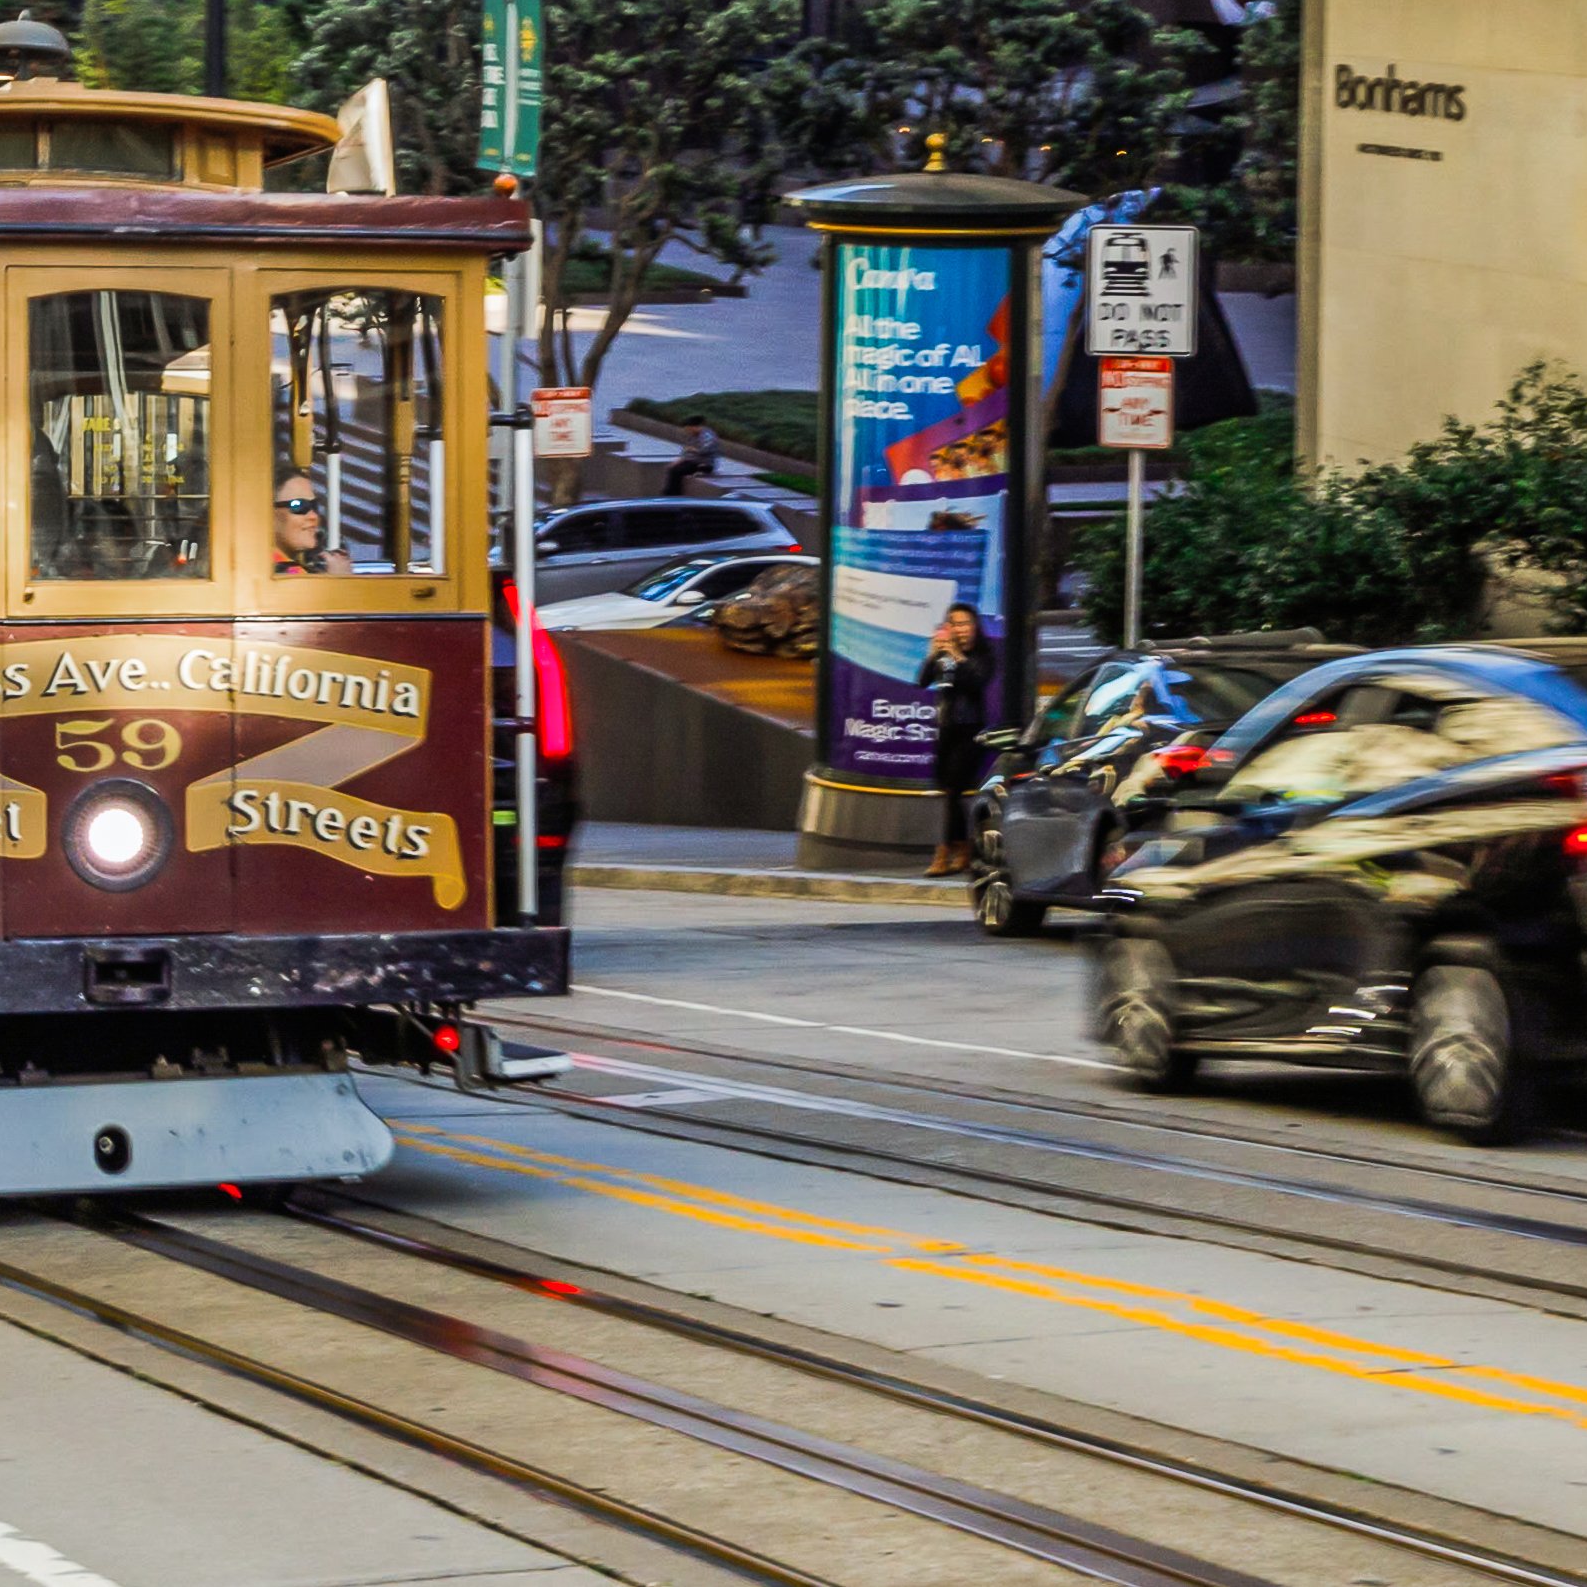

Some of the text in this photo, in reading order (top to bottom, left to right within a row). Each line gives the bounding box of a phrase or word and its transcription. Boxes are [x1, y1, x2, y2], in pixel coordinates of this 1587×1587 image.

[1336, 64, 1466, 121] Bonhams
[1098, 302, 1184, 321] DO NOT
[873, 316, 921, 340] the
[1111, 328, 1171, 349] PASS
[915, 343, 951, 367] of
[898, 376, 955, 394] one
[179, 647, 420, 718] California
[54, 717, 183, 772] 59
[227, 787, 432, 861] Streets
